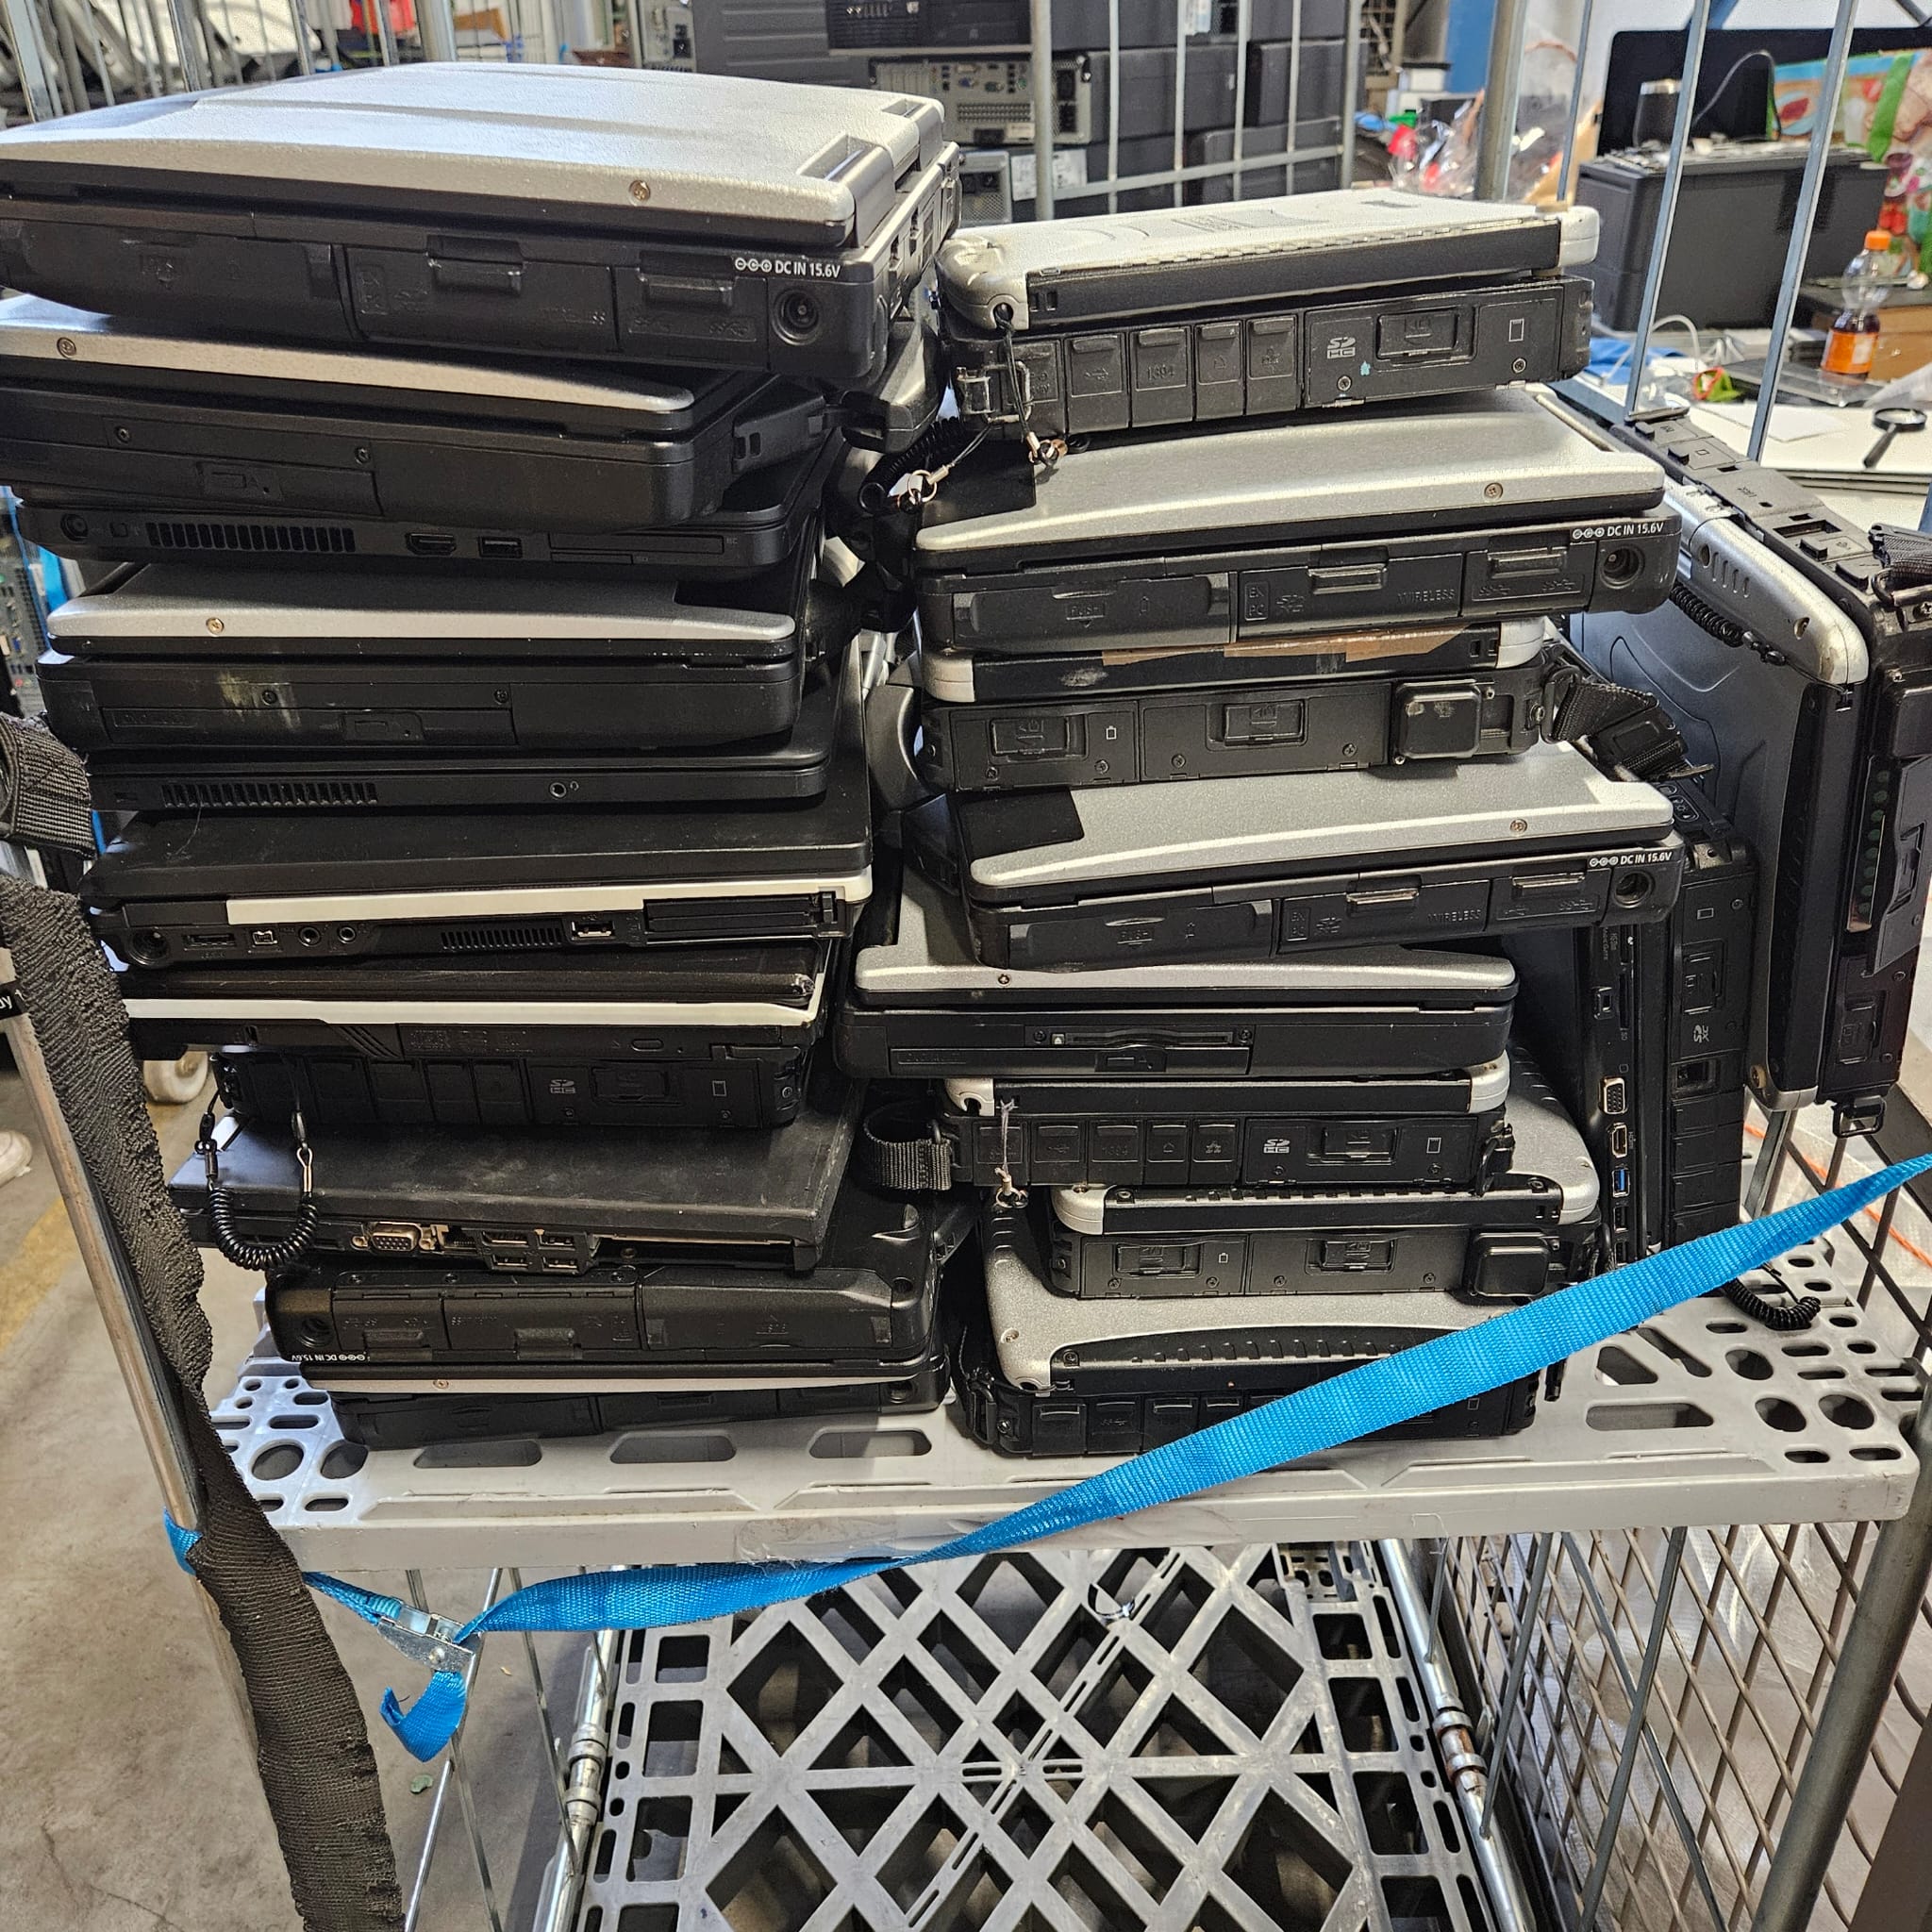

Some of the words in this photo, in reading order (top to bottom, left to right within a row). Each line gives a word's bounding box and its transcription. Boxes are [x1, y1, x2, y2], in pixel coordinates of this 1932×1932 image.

[774, 259, 792, 275] DC
[793, 261, 807, 276] IN
[809, 262, 841, 278] 15.6V
[1607, 525, 1623, 537] DC
[1623, 524, 1635, 536] IN
[1637, 522, 1664, 534] 15.6V
[1620, 855, 1634, 865] DC
[1634, 853, 1646, 864] IN
[1647, 851, 1673, 863] 15.6V
[291, 1354, 313, 1362] 15.6V
